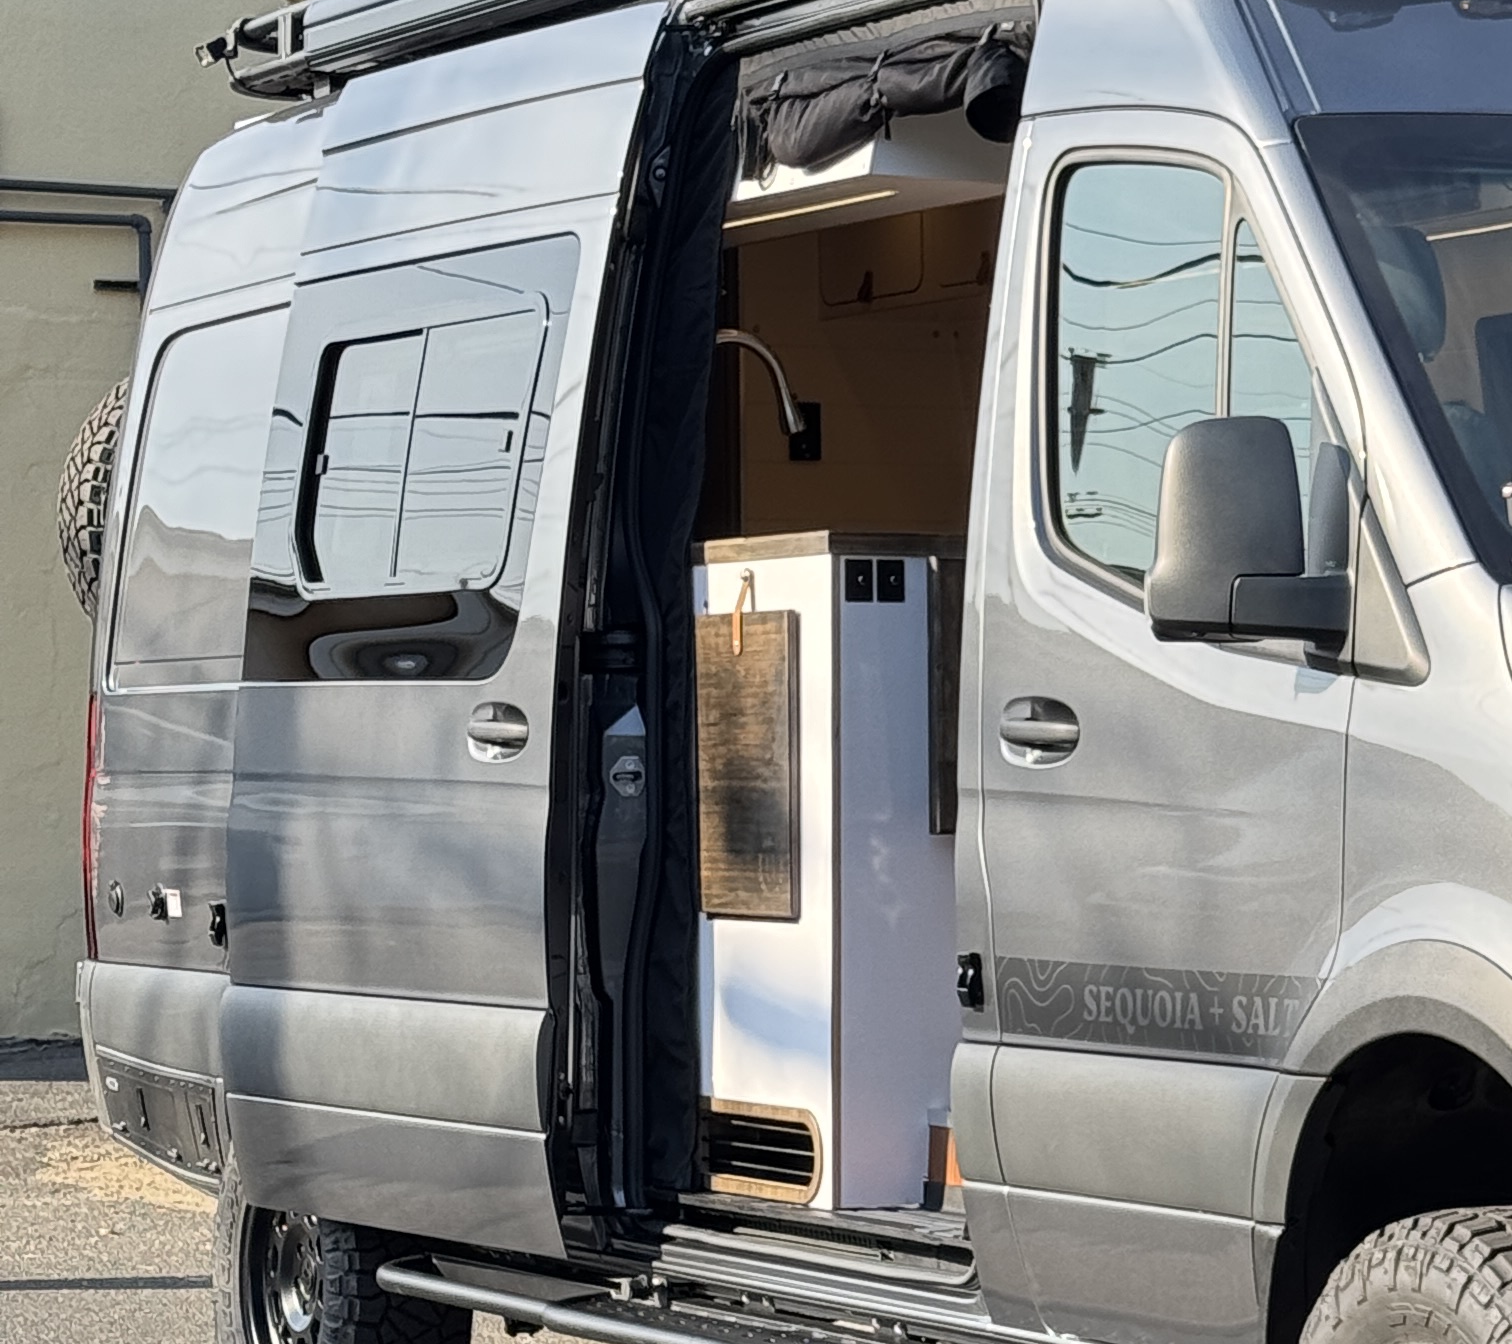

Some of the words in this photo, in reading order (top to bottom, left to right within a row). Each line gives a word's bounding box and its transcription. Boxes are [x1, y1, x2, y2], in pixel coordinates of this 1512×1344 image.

[1083, 984, 1204, 1034] SEQUOIA
[1210, 999, 1224, 1026] +
[1231, 994, 1300, 1037] SALT
